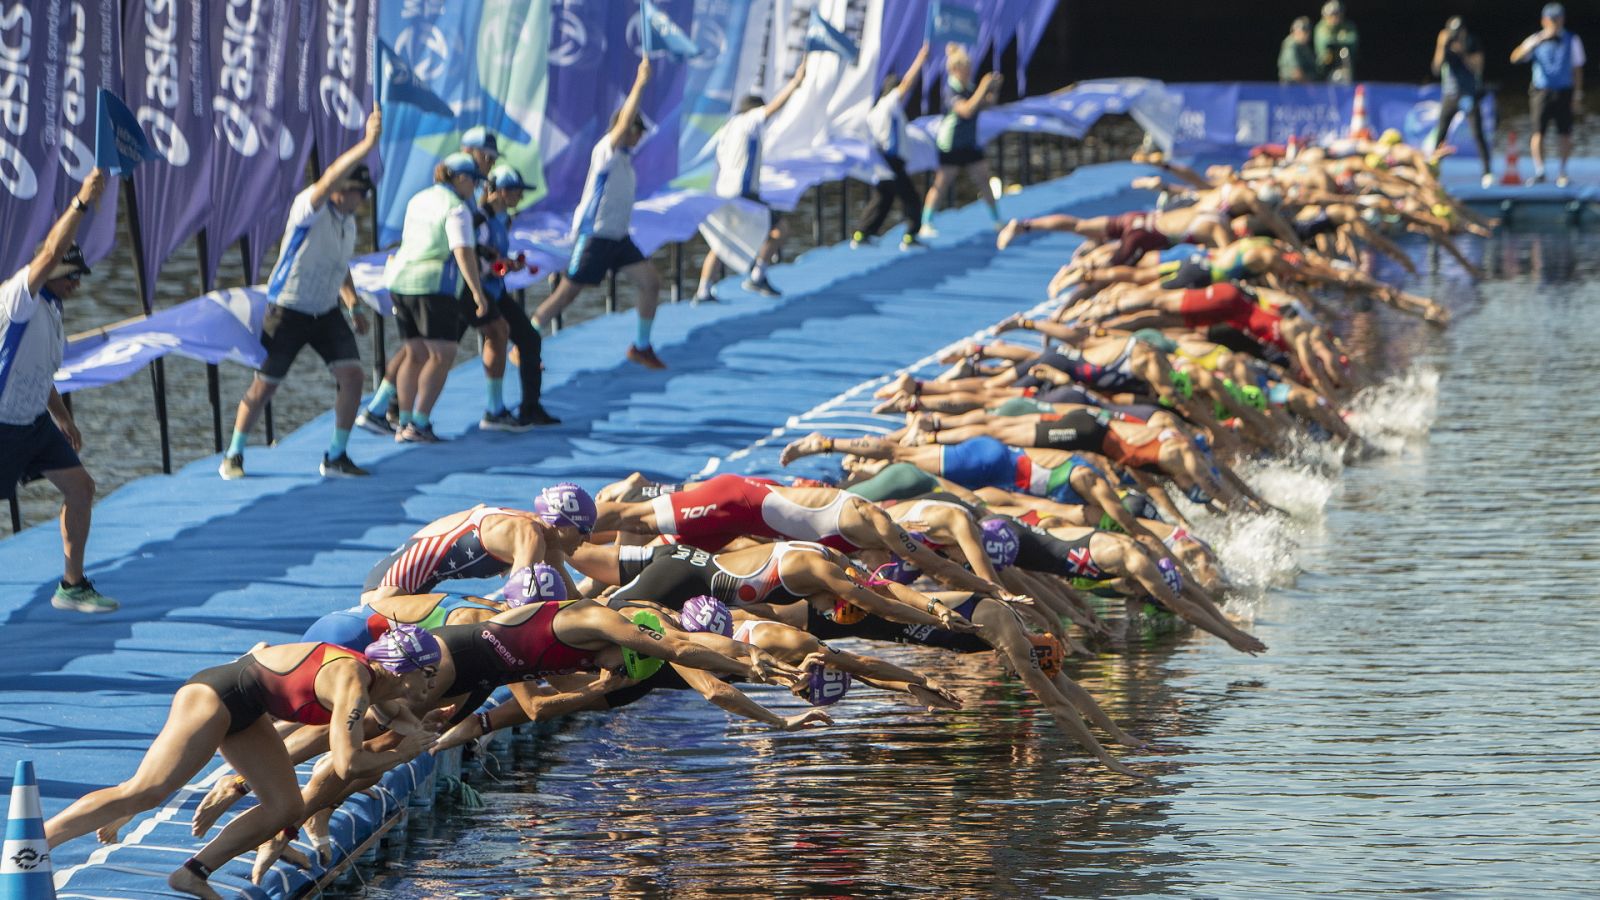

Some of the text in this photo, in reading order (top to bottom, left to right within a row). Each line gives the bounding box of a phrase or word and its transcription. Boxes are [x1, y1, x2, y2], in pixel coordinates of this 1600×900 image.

[547, 491, 580, 513] 56
[986, 540, 1004, 565] 57
[522, 572, 554, 598] 52
[696, 604, 727, 635] 55
[823, 667, 843, 698] 60
